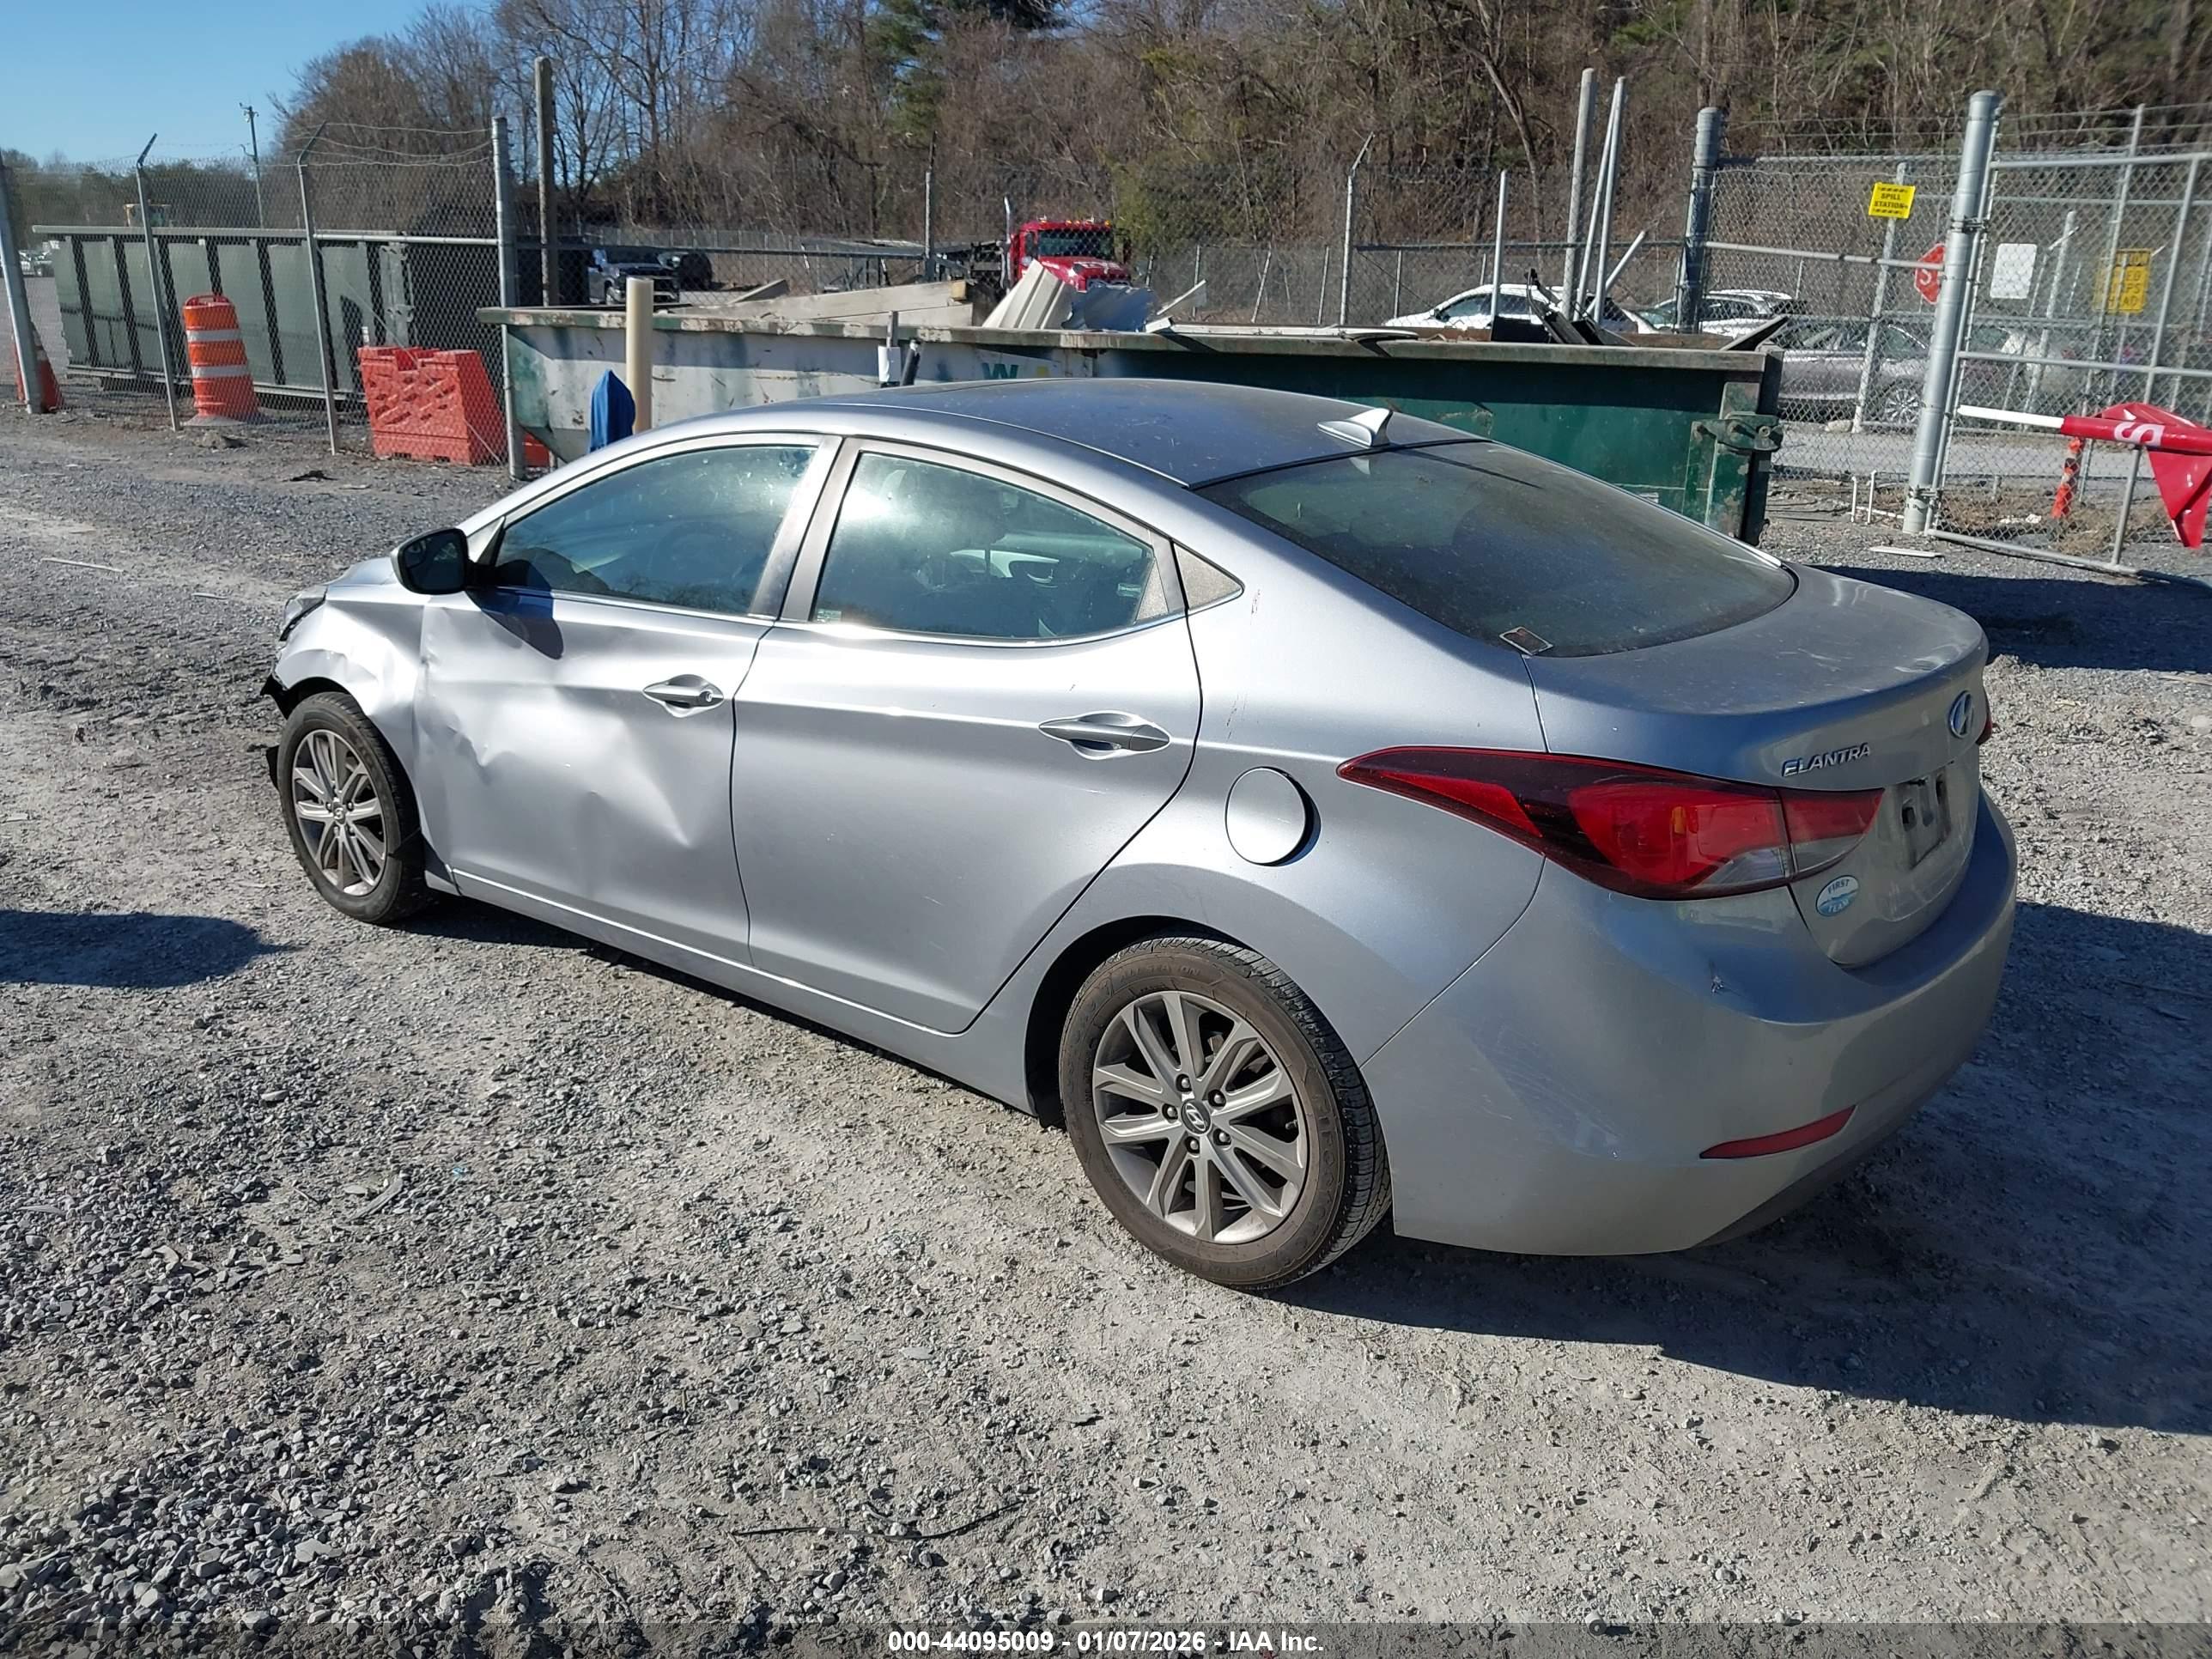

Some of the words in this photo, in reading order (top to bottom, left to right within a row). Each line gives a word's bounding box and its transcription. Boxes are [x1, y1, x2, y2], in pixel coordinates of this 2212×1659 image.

[1881, 192, 1901, 201] SPILL
[1782, 742, 1870, 777] ELANTRA
[1827, 878, 1850, 894] FIRST
